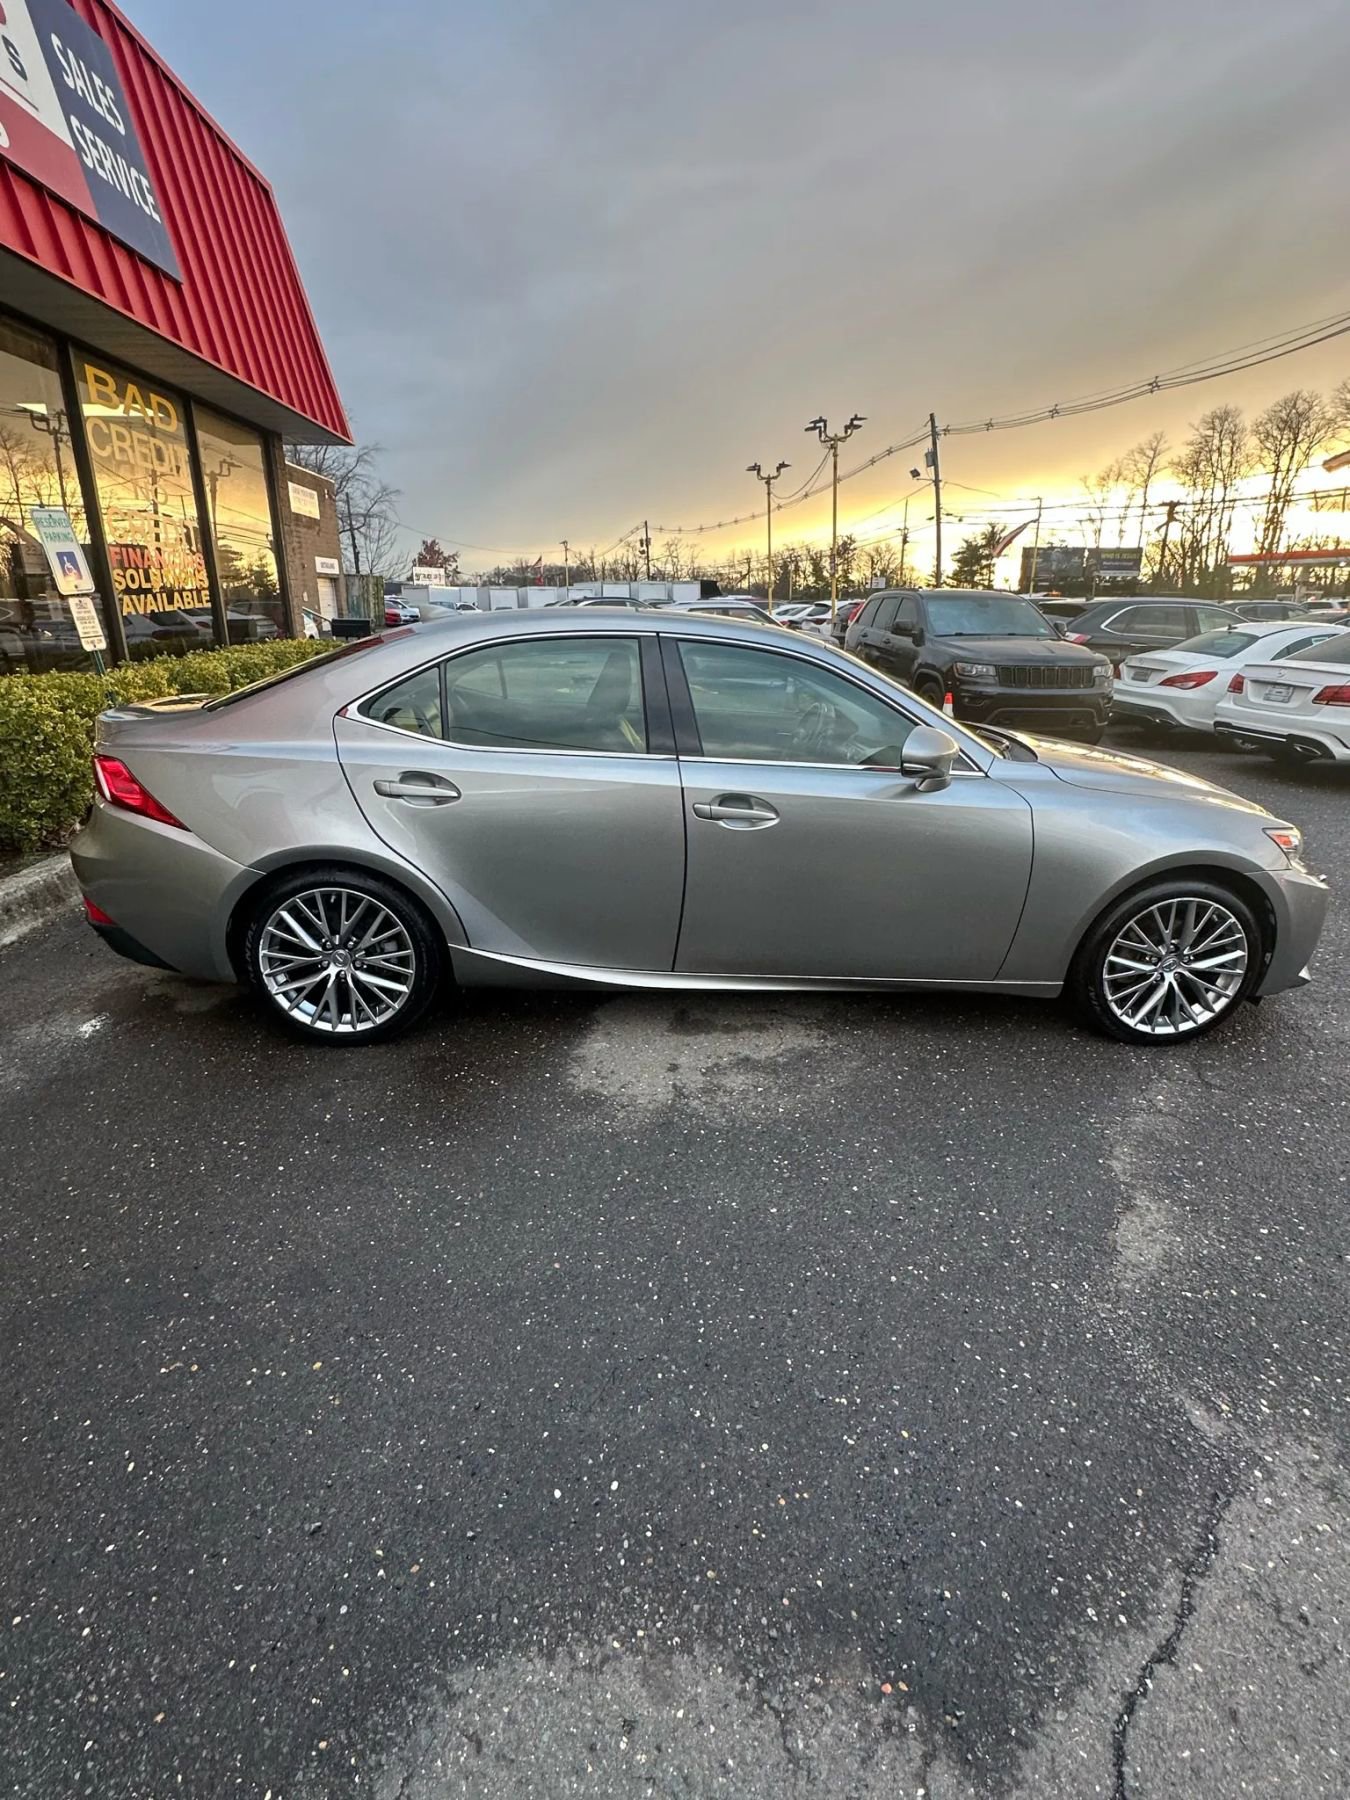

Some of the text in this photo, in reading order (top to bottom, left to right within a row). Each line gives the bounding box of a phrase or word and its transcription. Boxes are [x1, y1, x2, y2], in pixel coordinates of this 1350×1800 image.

[51, 33, 125, 136] SALES
[70, 114, 162, 224] SERVICE
[84, 363, 178, 433] BAD
[86, 417, 190, 478] CREDIT
[36, 517, 70, 528] RESERVED
[43, 531, 74, 542] PARKING
[122, 590, 212, 616] AVAILABLE
